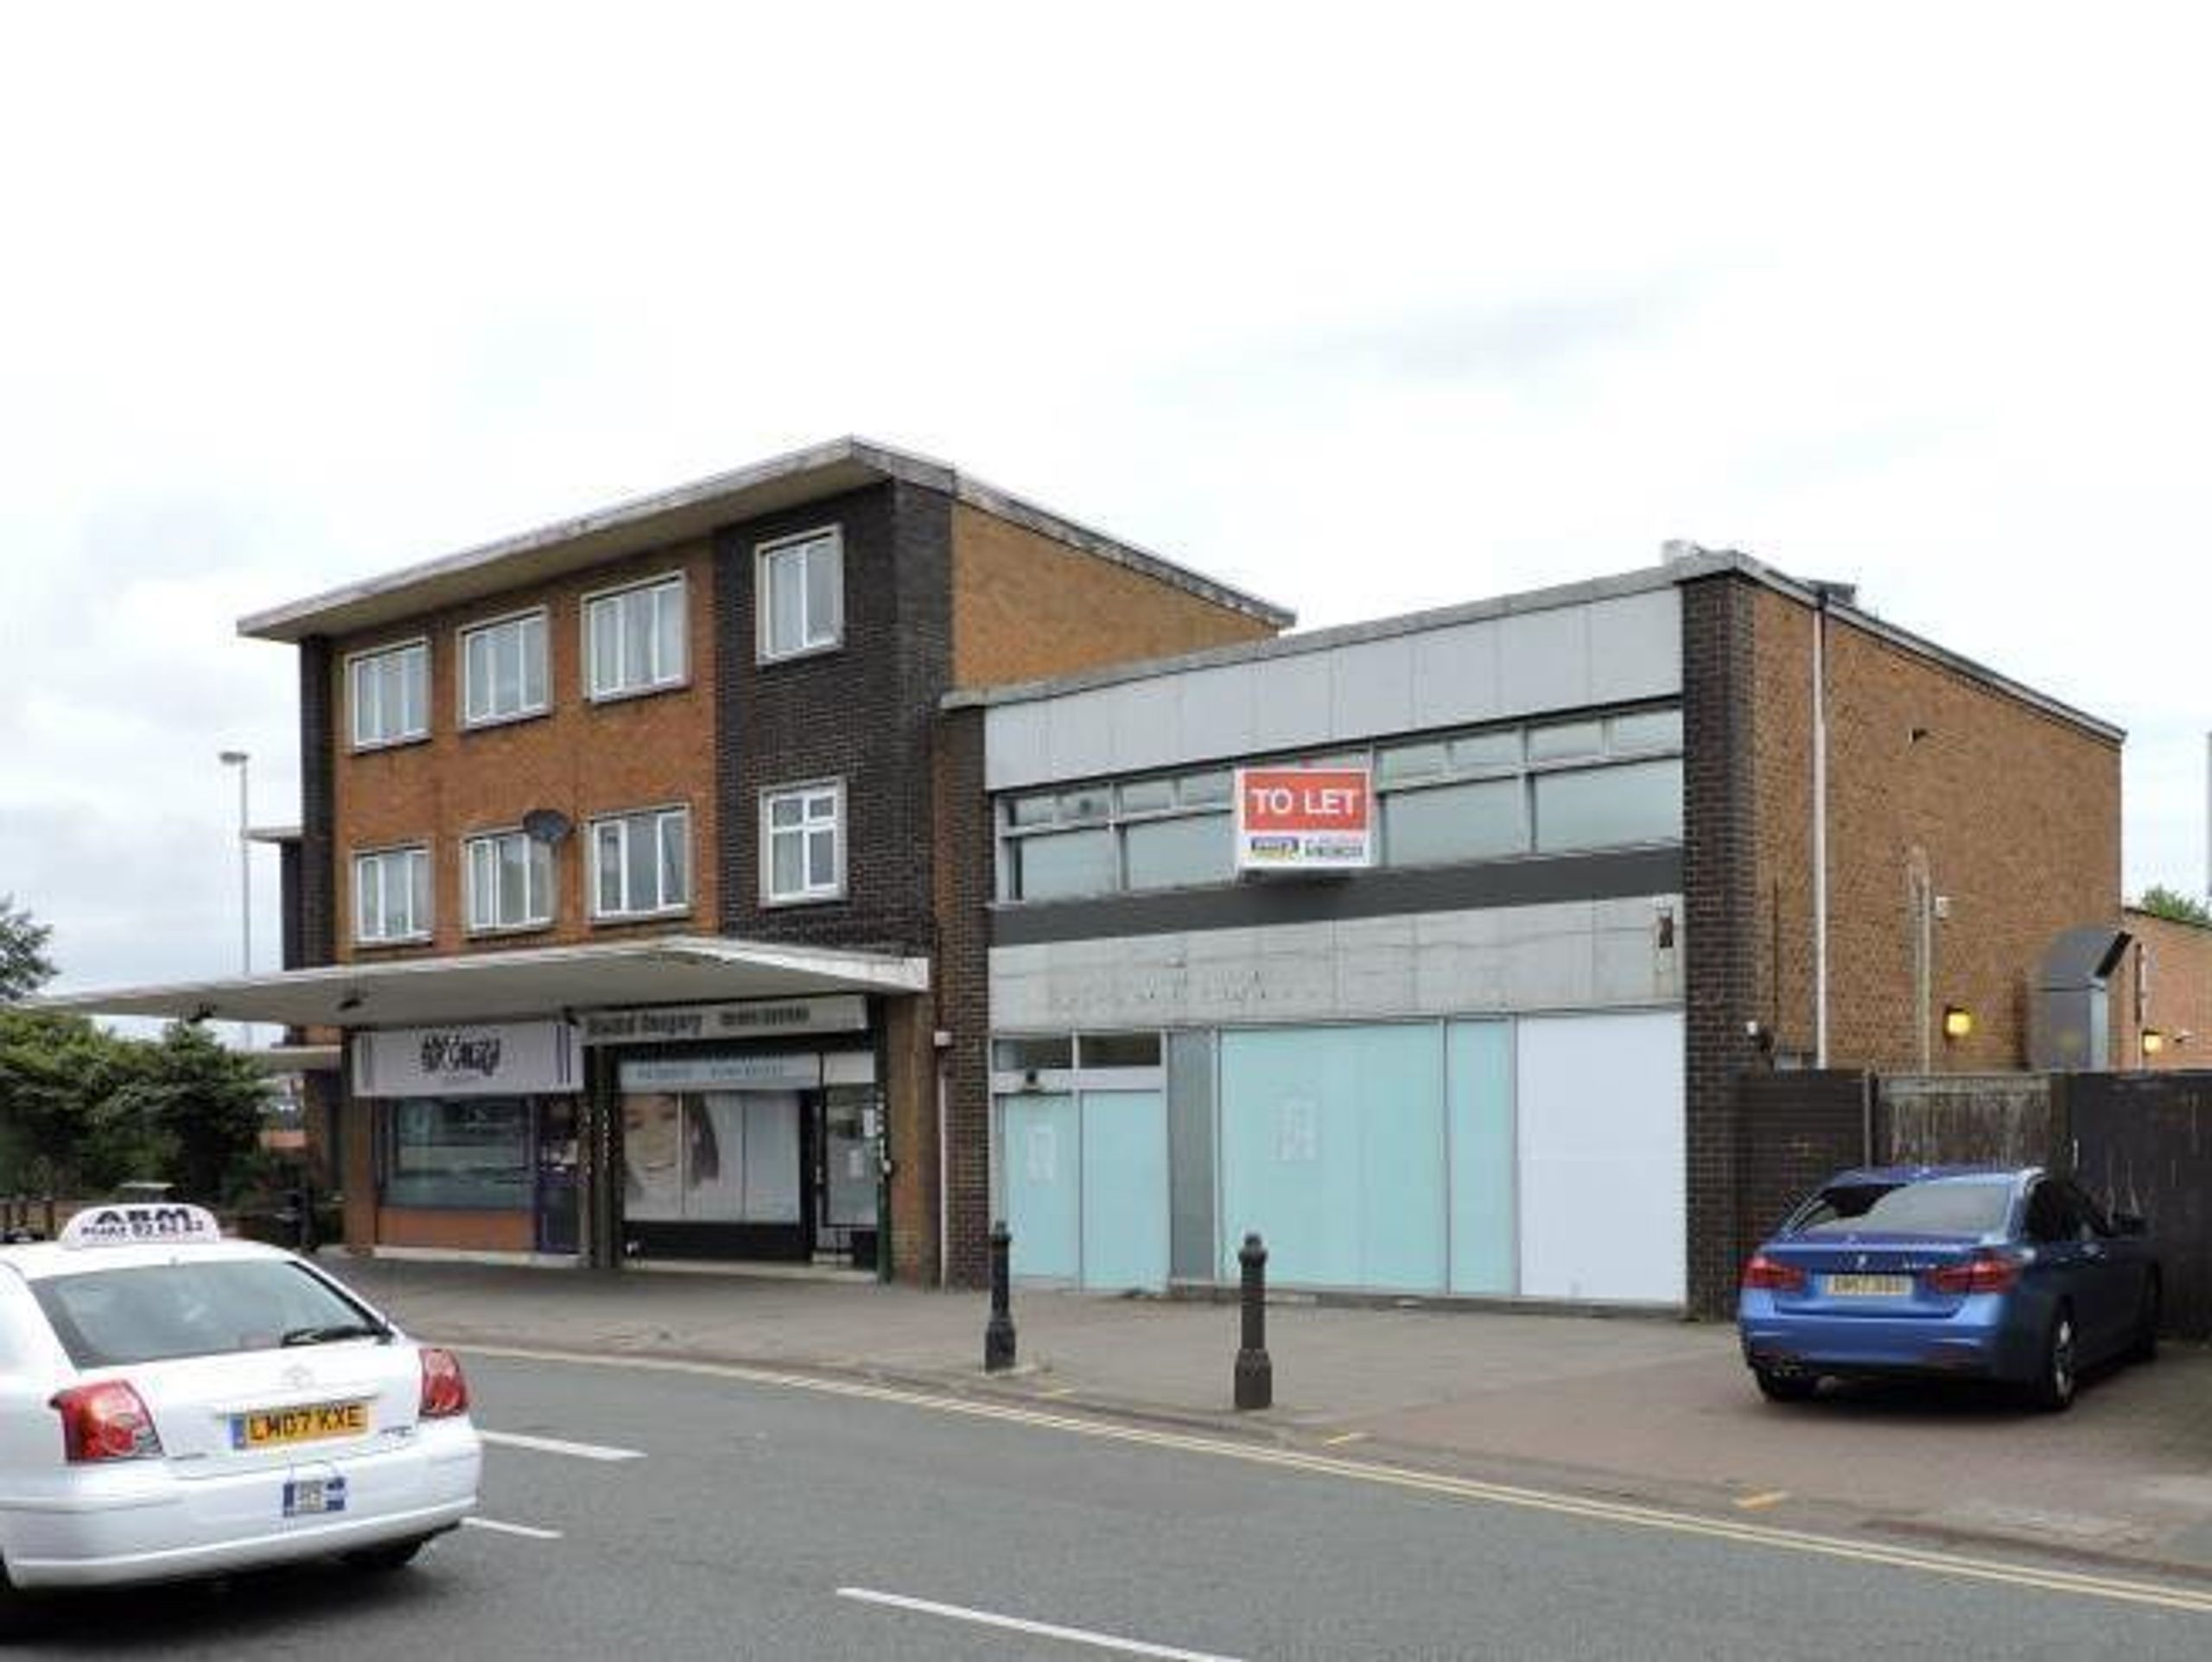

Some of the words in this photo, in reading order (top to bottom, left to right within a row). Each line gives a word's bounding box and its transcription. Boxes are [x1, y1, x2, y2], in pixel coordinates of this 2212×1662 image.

[1251, 788, 1294, 815] TO
[1304, 788, 1361, 815] LET
[249, 1412, 312, 1441] LM07
[319, 1404, 364, 1431] KXE
